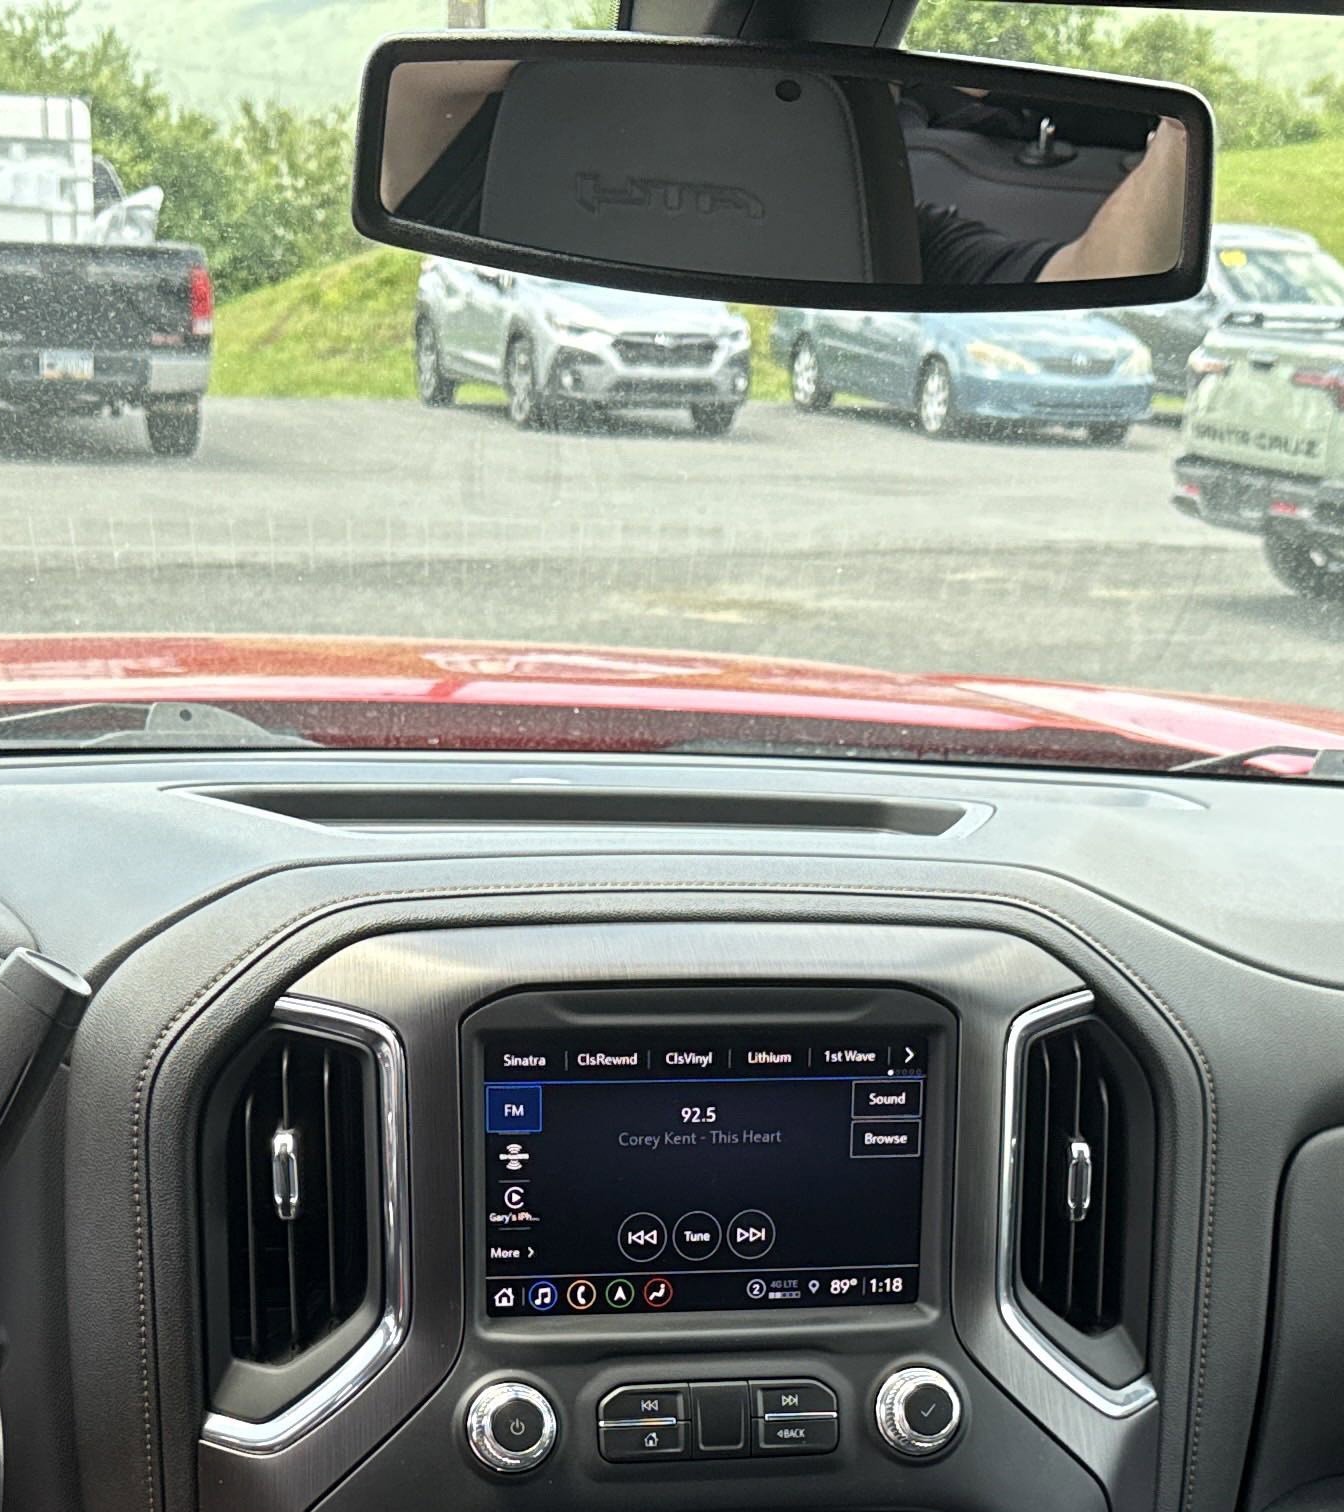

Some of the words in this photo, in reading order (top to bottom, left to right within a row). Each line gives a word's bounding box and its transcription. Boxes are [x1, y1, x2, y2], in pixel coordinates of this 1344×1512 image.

[503, 1054, 546, 1067] Sinatra
[577, 1053, 638, 1066] ClsRewnd
[665, 1052, 713, 1069] ClsVinyl
[747, 1051, 792, 1064] Lithium
[824, 1050, 843, 1063] 1st
[844, 1050, 876, 1062] Wave
[869, 1092, 906, 1105] Sound
[504, 1104, 524, 1117] FM
[681, 1107, 717, 1123] 92.5
[618, 1132, 660, 1150] Corey
[664, 1131, 697, 1145] Kent
[710, 1130, 739, 1144] This
[742, 1129, 782, 1143] Heart
[864, 1132, 908, 1145] Browse
[684, 1230, 711, 1242] Tune
[490, 1248, 520, 1259] More
[752, 1284, 761, 1295] 2
[783, 1280, 799, 1288] LTE
[869, 1278, 903, 1293] 1:18
[783, 1429, 805, 1439] BACK
